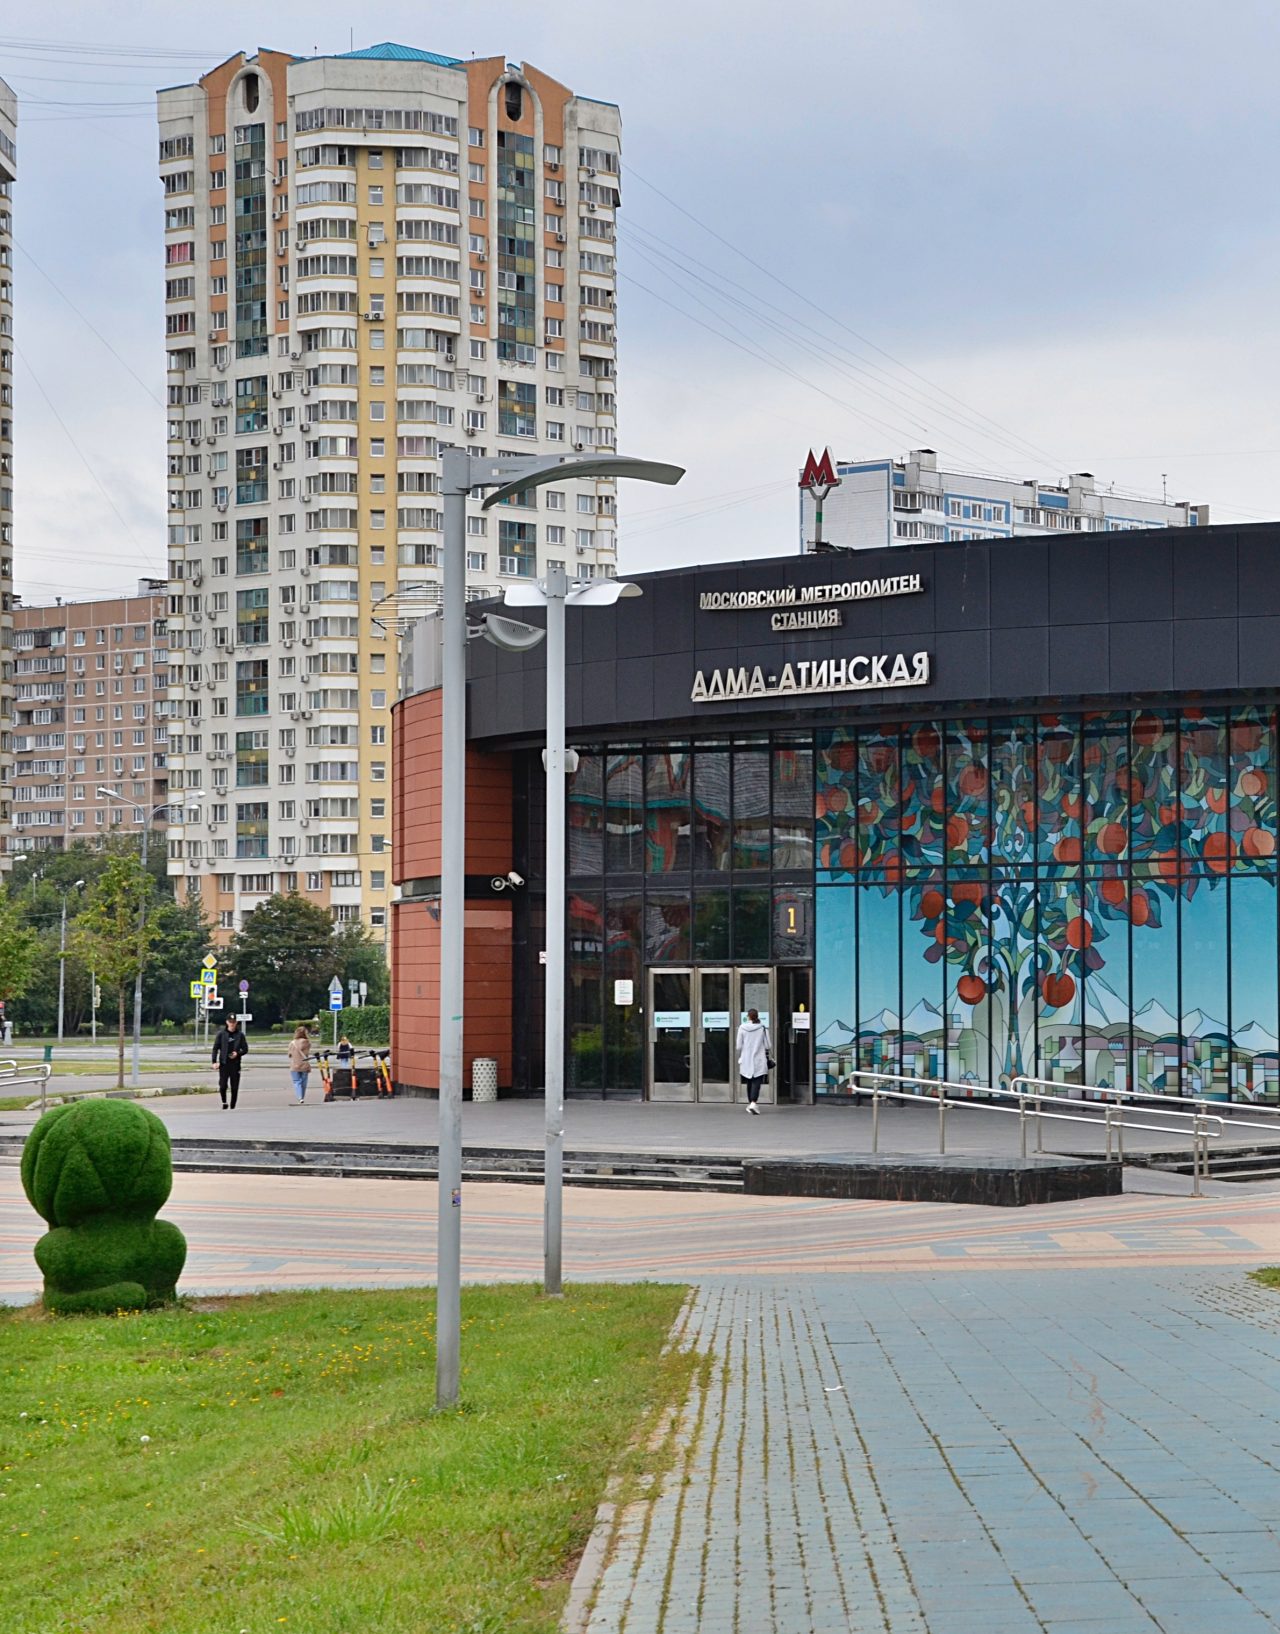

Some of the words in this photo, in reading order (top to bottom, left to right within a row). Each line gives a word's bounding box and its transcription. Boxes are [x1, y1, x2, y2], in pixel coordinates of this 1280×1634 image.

[799, 446, 837, 487] М
[700, 585, 796, 608] МОСКОВСКИЙ
[801, 574, 920, 600] МЕТРОПОЛИТЕН
[771, 609, 838, 629] СТАНЦИЯ
[691, 652, 928, 700] АЛМА-АТИНСКАЯ
[788, 907, 795, 927] 1
